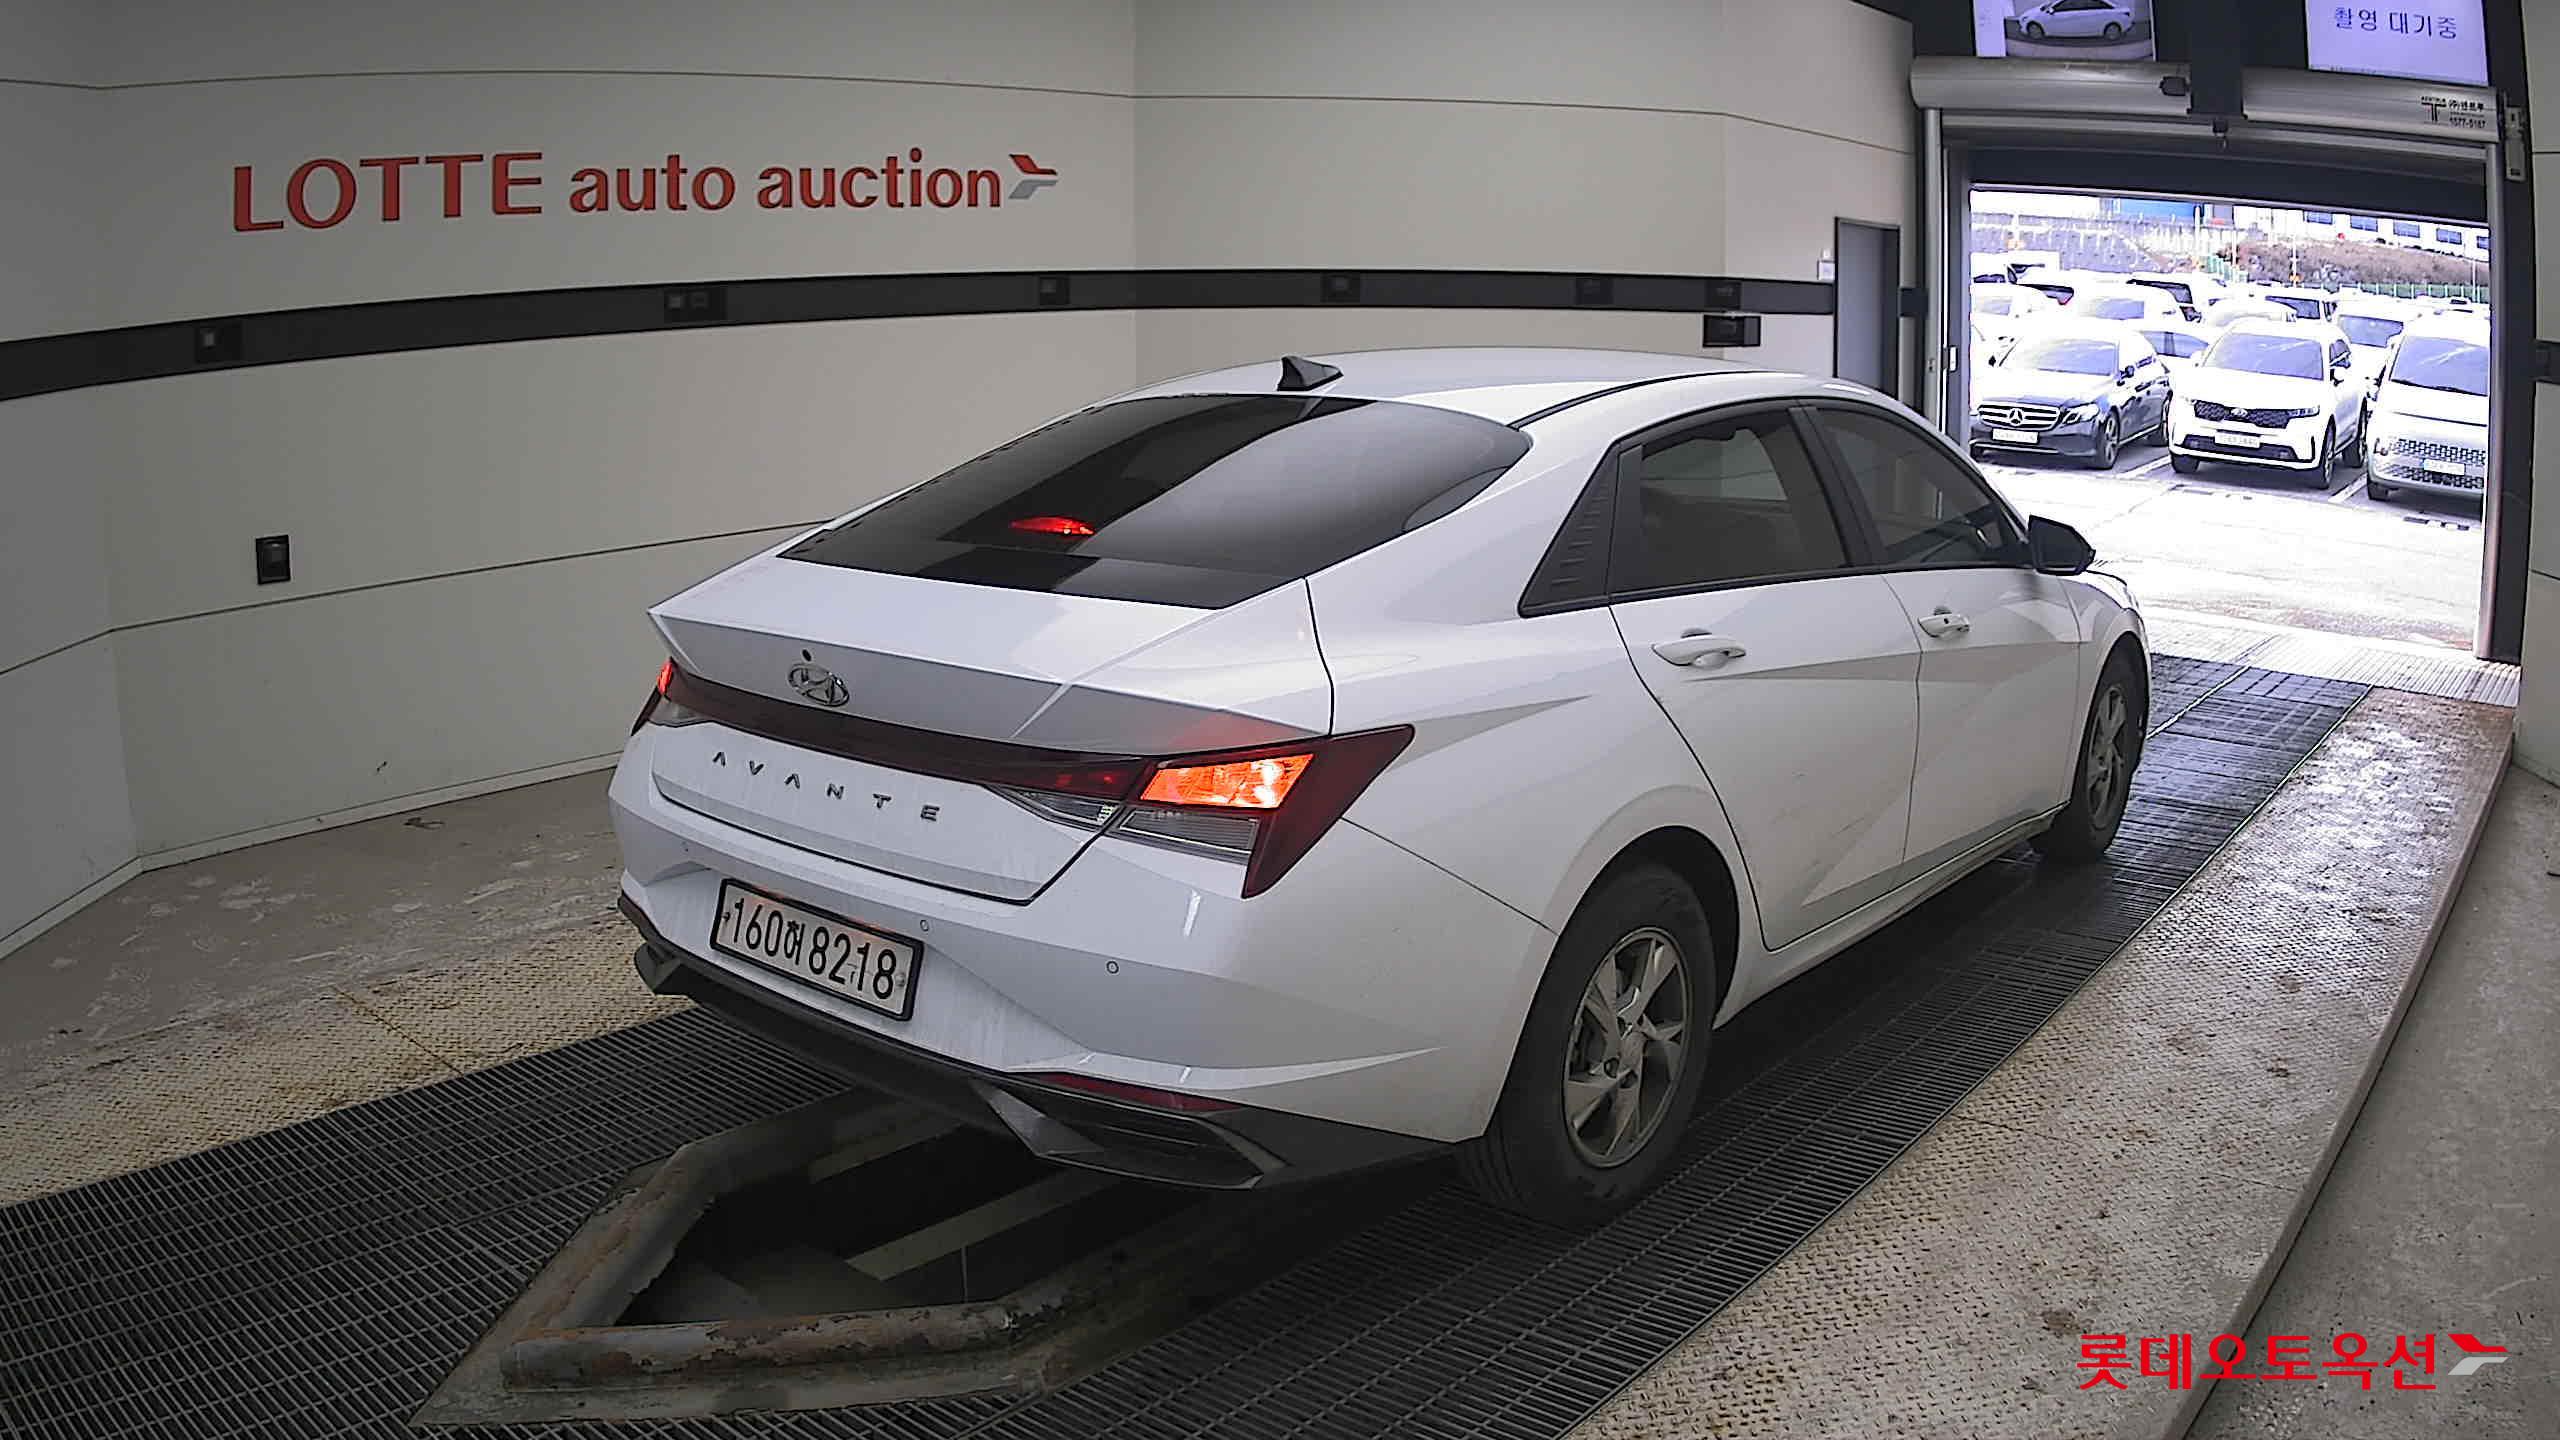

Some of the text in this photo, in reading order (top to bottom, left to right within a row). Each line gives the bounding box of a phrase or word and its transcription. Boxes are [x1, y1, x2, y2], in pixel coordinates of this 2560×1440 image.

[2334, 7, 2457, 39] 촬영 대기중
[233, 147, 1001, 232] LOTTE auto auction
[713, 751, 940, 821] AVANTE
